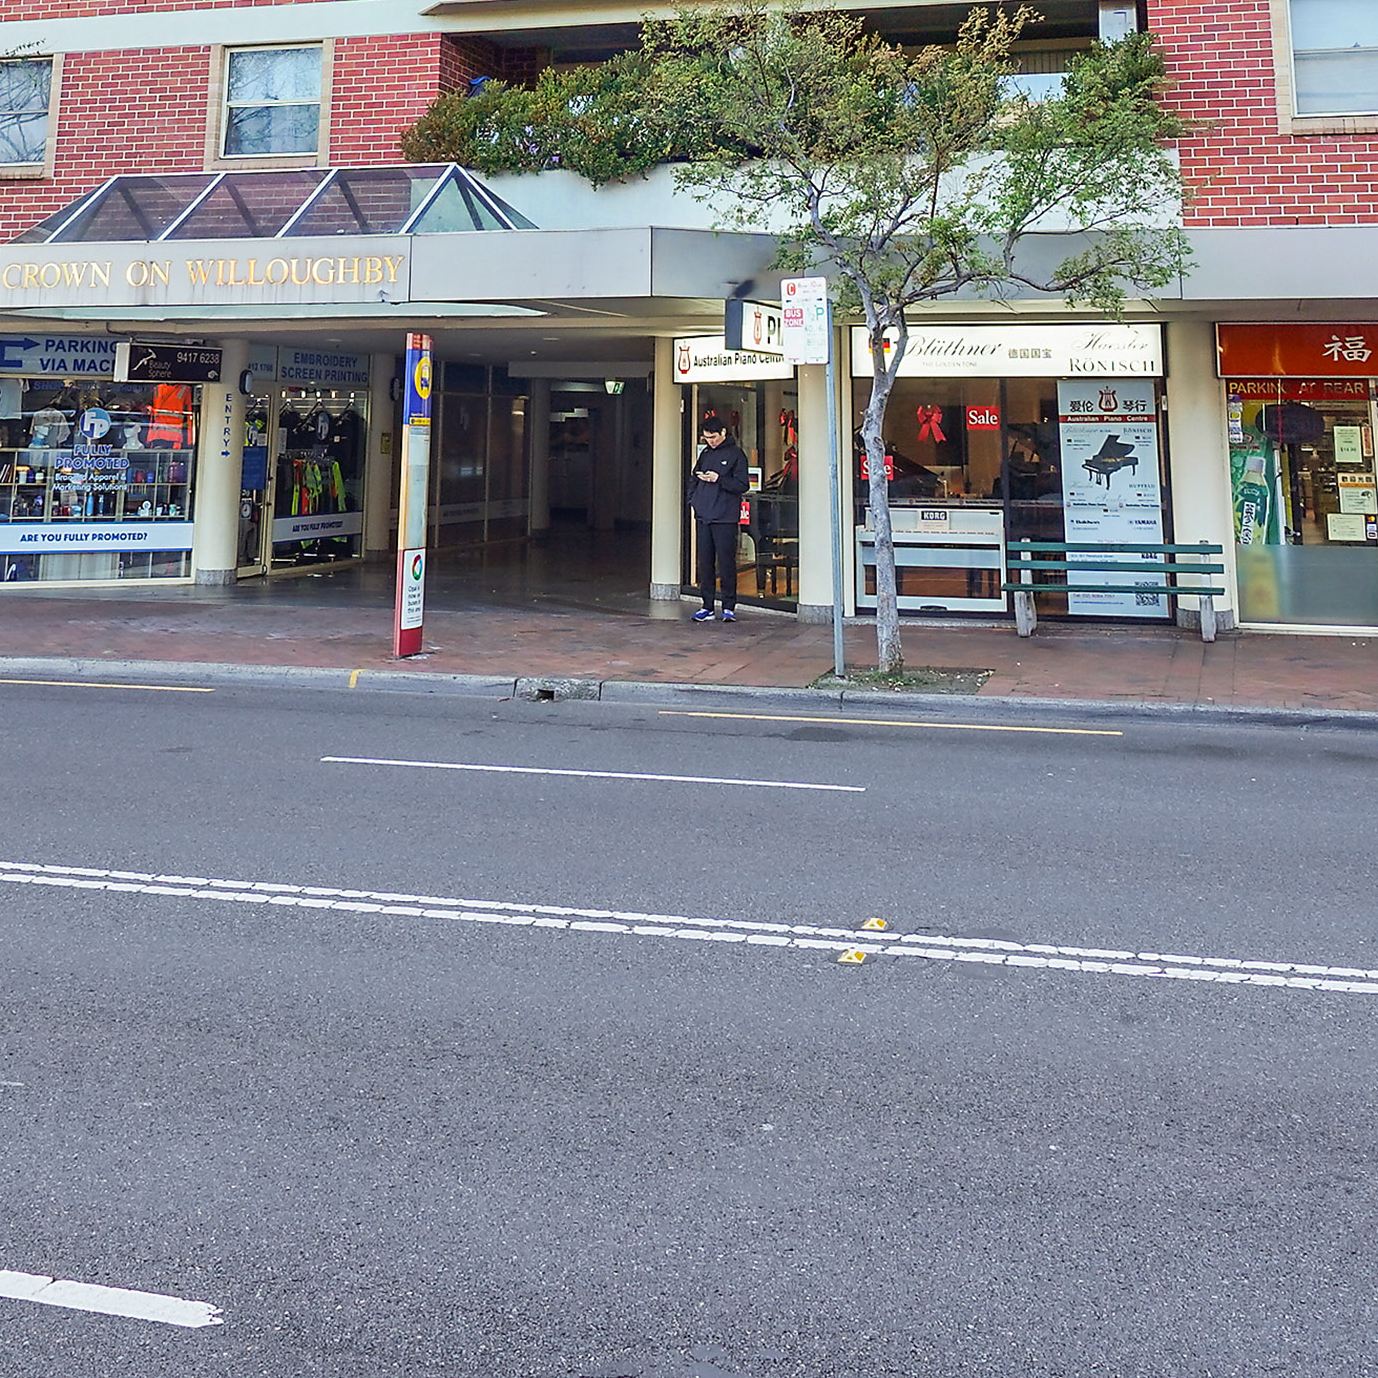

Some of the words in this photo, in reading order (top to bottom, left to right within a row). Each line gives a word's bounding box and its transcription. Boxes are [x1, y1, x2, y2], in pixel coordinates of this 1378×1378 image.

[2, 261, 112, 289] CROWN
[125, 260, 171, 287] ON
[186, 255, 405, 286] WILLOUGHBY
[786, 310, 802, 318] BUS
[785, 318, 803, 327] ZONE
[767, 316, 783, 346] PI
[904, 335, 1002, 357] Blüthner
[177, 352, 197, 363] 9417
[199, 353, 220, 364] 6238
[294, 352, 358, 368] EMBROIDERY
[693, 353, 732, 367] Australian
[734, 352, 756, 365] Piano
[39, 358, 68, 371] VIA
[149, 360, 171, 370] Beauty
[148, 369, 171, 379] Sphere
[281, 367, 321, 380] SCREEN
[324, 369, 368, 382] PRINTING
[1229, 382, 1289, 394] PARKIN
[1299, 382, 1316, 394] AT
[1324, 382, 1364, 394] REAR
[223, 393, 233, 447] ENTRY
[968, 410, 998, 426] Sale
[74, 444, 112, 456] FULLY
[55, 458, 130, 469] PROMOTED
[862, 461, 891, 474] Se
[923, 511, 946, 520] KORG
[20, 533, 39, 543] ARE
[41, 533, 62, 542] YOU
[63, 533, 89, 542] FULLY
[91, 532, 148, 542] PROMOTED?
